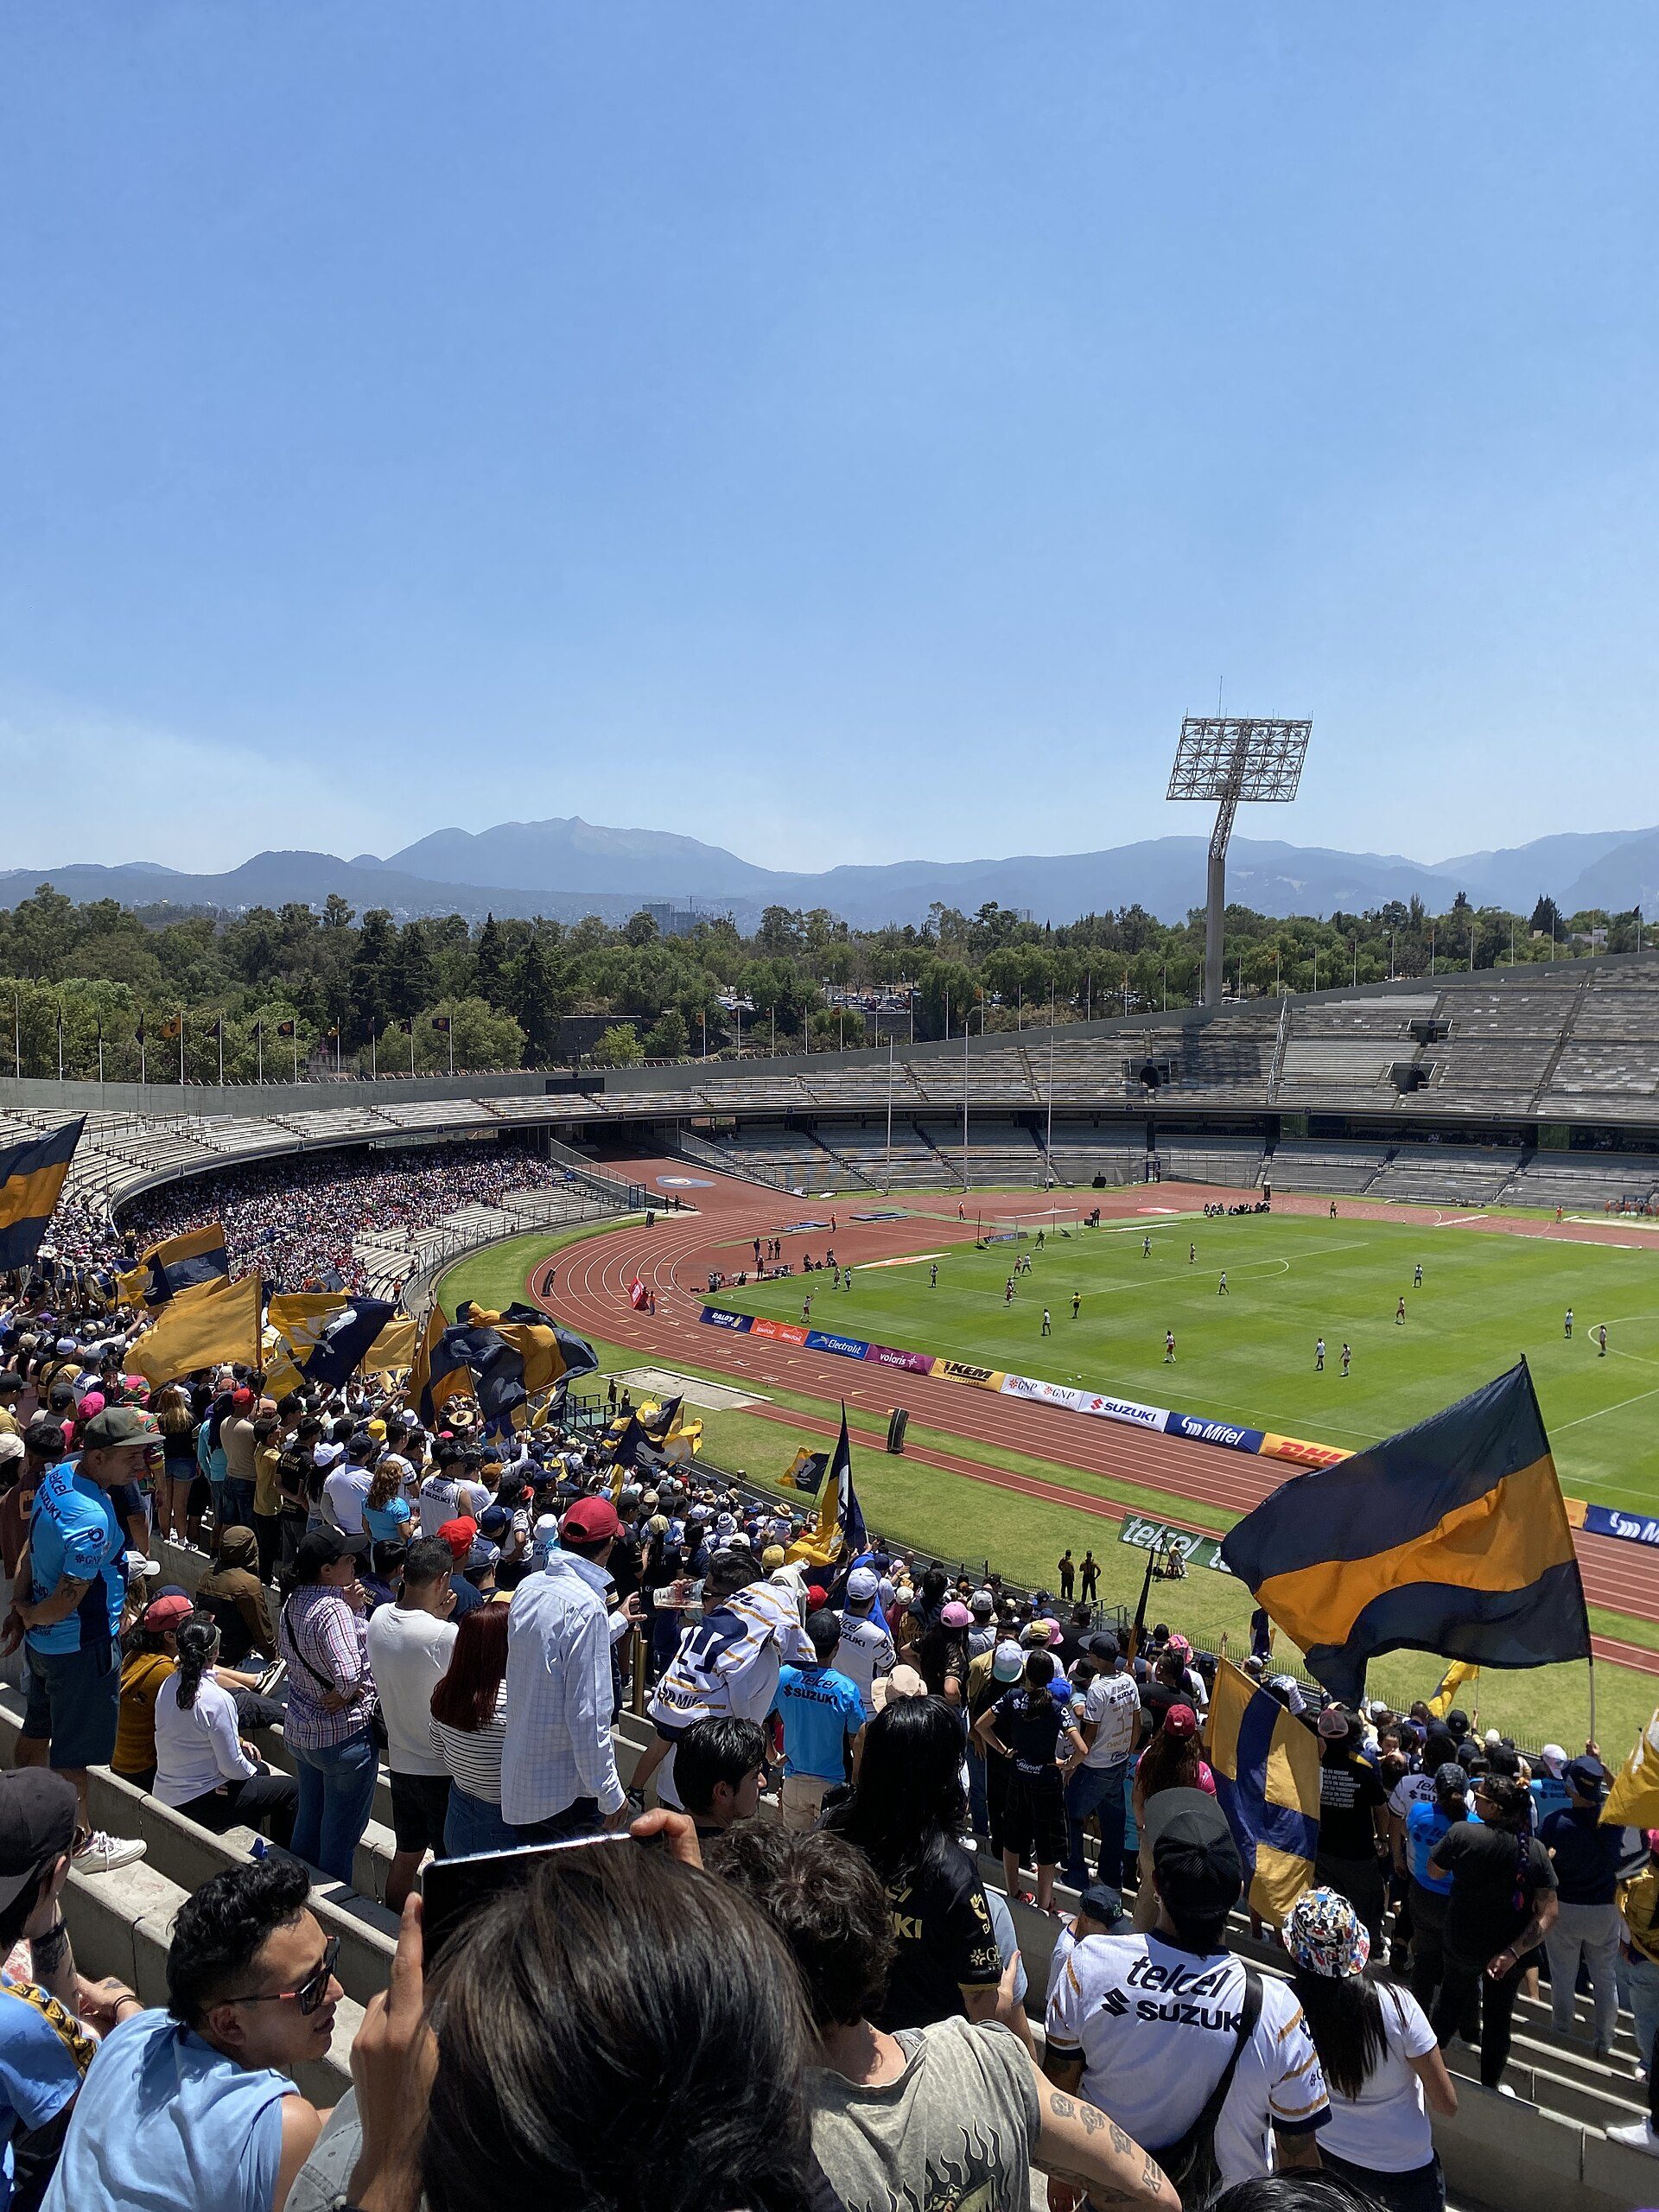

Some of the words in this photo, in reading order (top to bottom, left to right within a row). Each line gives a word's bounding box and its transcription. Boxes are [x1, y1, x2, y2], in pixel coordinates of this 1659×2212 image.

[828, 1339, 861, 1355] Electrolit
[880, 1352, 907, 1365] volaris
[950, 1363, 995, 1379] KEM
[1018, 1380, 1038, 1391] GNP
[1052, 1388, 1075, 1400] GNP
[1104, 1402, 1156, 1422] SUZUKI
[1202, 1422, 1245, 1446] Mifel
[1276, 1441, 1344, 1465] DHL
[425, 1491, 450, 1503] SUZUKI
[801, 1674, 839, 1690] telcel
[794, 1688, 838, 1706] SUZUKI
[1126, 1955, 1233, 1998] telcel
[1135, 1999, 1242, 2032] SUZUK
